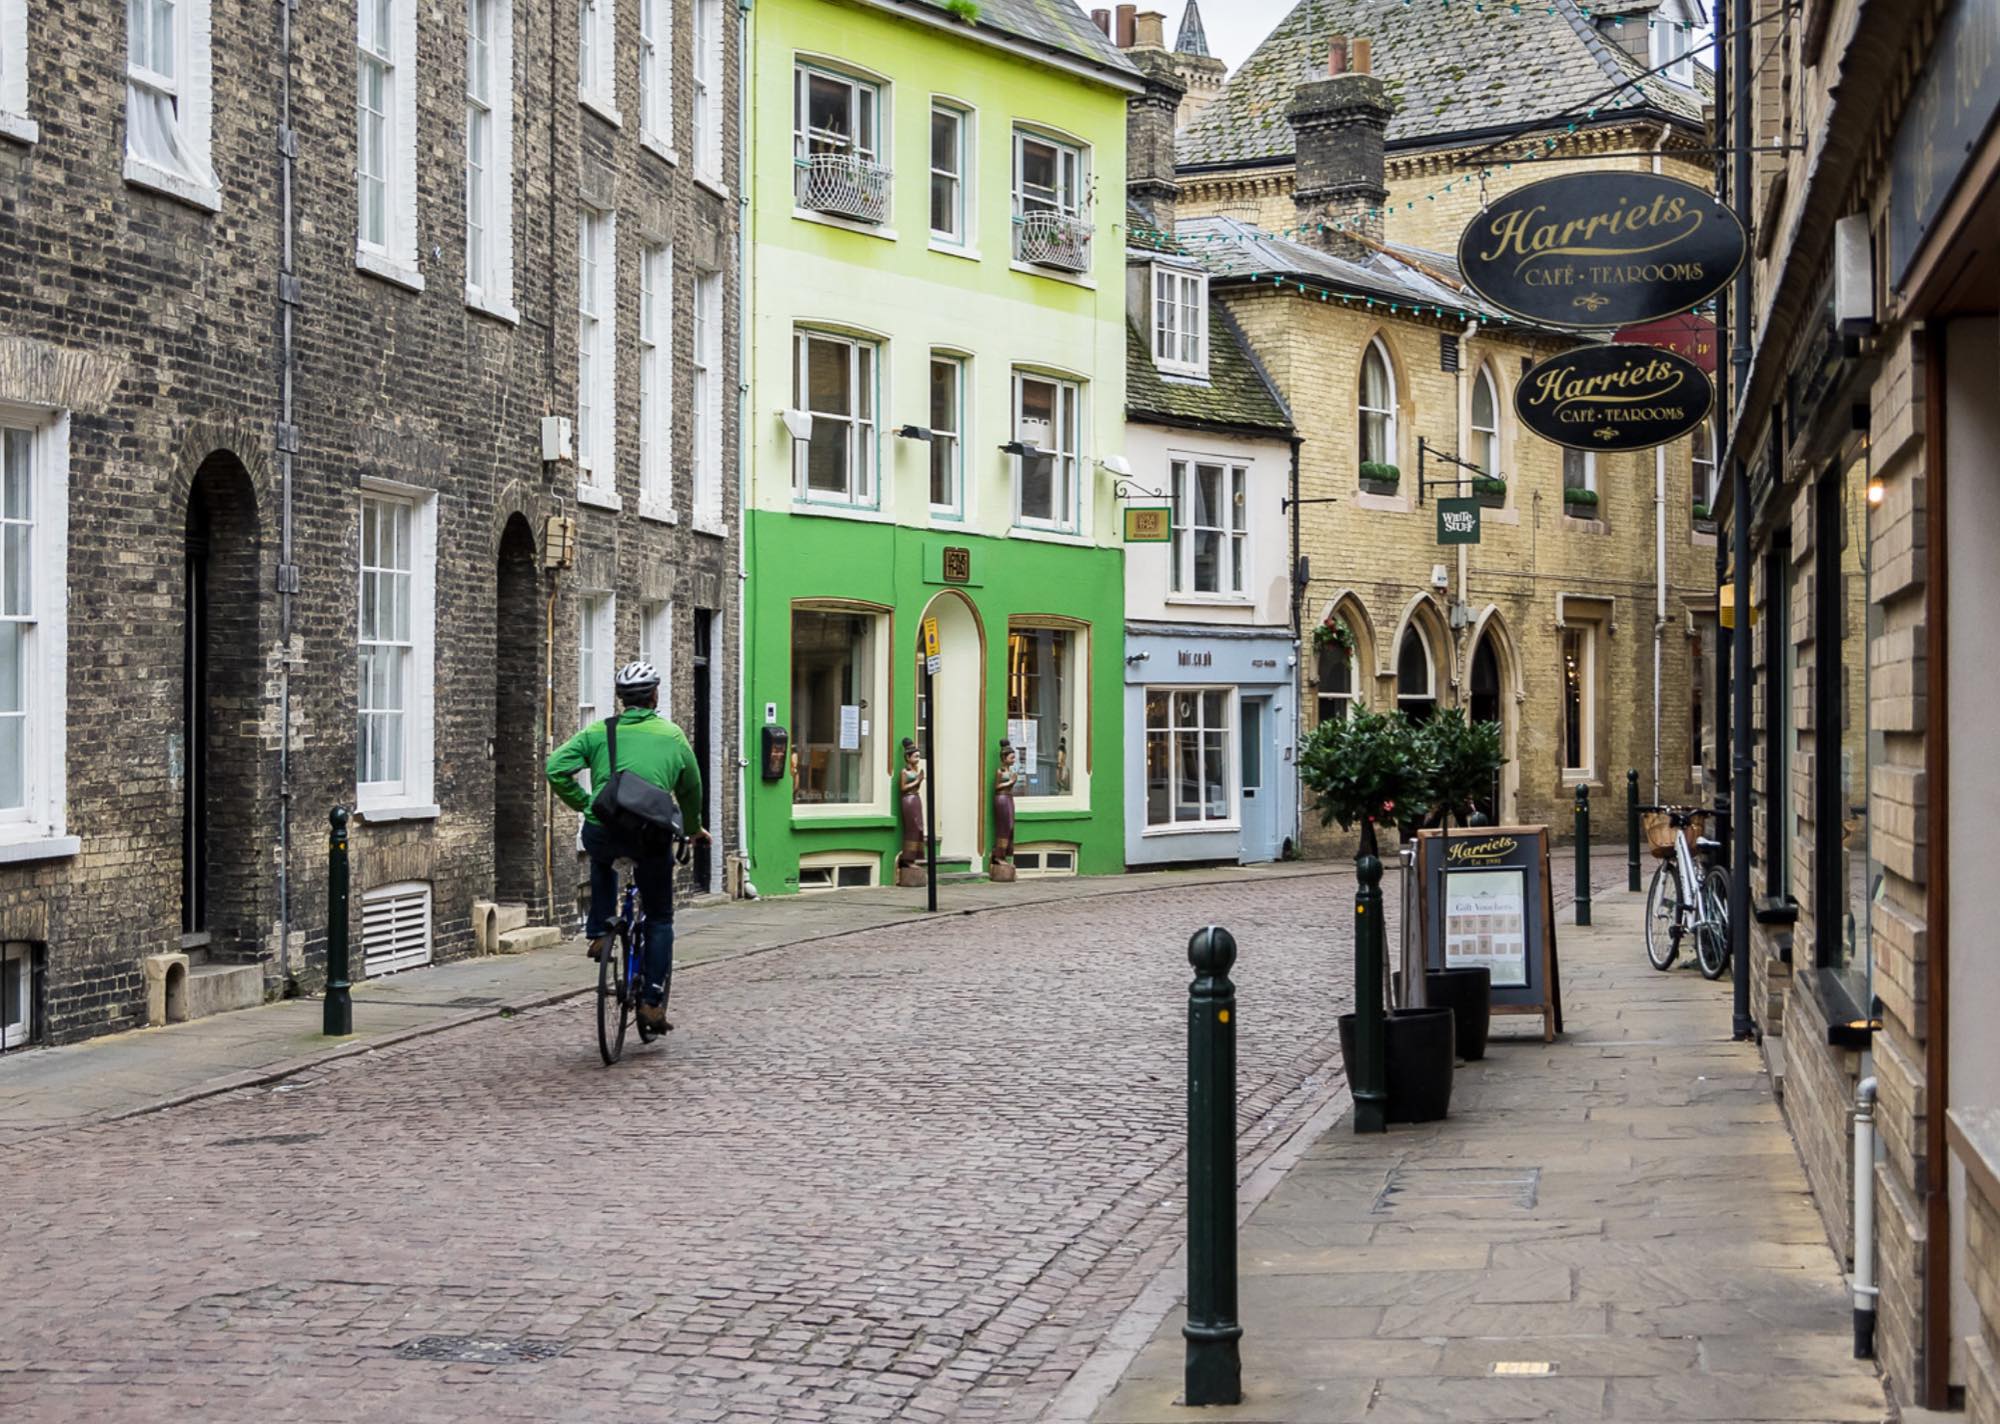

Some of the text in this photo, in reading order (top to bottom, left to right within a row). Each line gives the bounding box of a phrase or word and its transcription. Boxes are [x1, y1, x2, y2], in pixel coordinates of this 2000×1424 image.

[1480, 194, 1702, 263] Harriets
[1525, 263, 1704, 286] CAFÉ TEAROOMS
[1654, 343, 1711, 355] SAW
[1529, 359, 1684, 406] Harriets
[1559, 406, 1684, 423] CAFÉ TEAROOMS
[1447, 837, 1517, 861] Harriets
